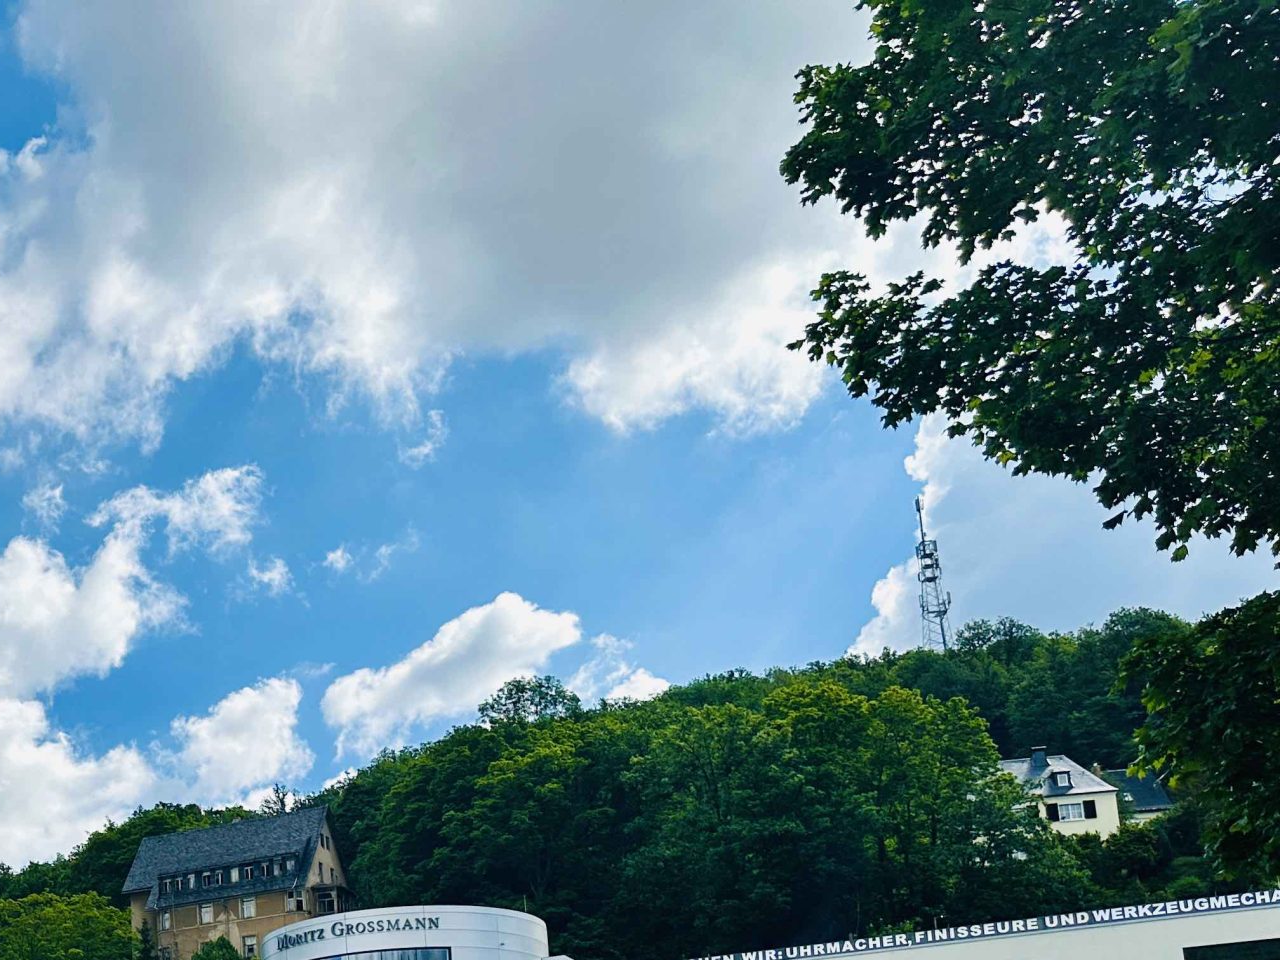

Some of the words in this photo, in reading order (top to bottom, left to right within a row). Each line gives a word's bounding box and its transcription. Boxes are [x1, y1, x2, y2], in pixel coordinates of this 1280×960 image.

[276, 928, 325, 952] MORITZ
[331, 917, 440, 937] GROSSMANN
[915, 917, 1039, 943] FINISSEURE
[1044, 911, 1089, 928] UND
